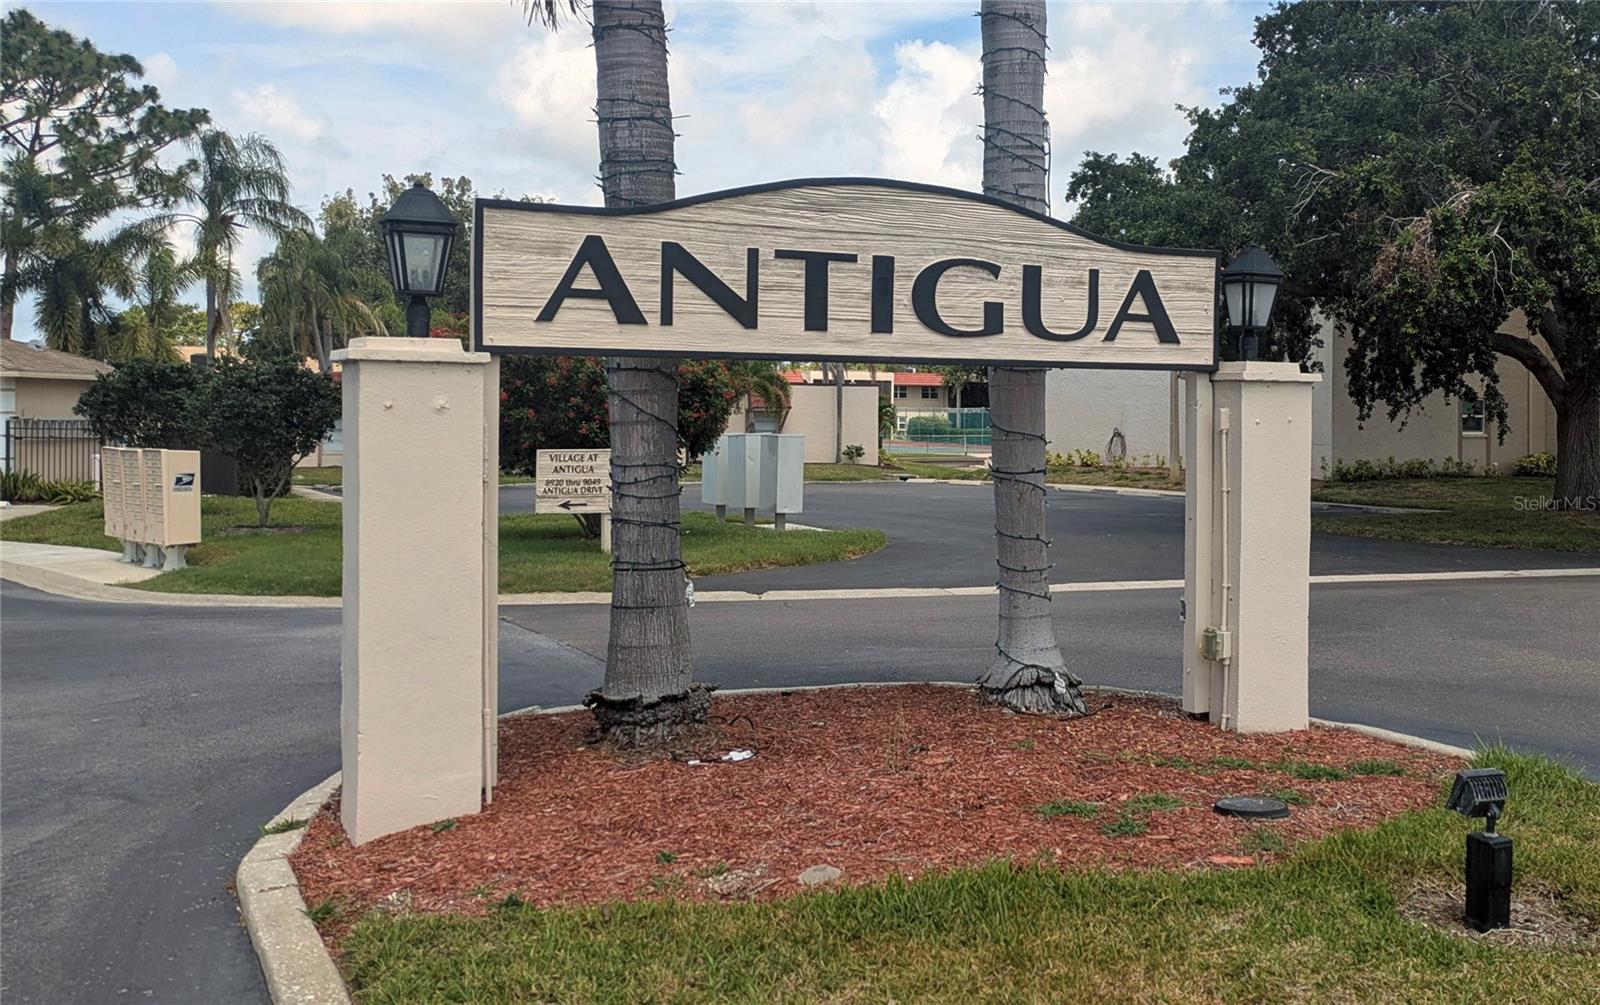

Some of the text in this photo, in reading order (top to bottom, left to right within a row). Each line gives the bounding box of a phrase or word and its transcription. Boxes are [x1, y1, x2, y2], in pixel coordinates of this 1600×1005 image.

[534, 235, 1181, 344] ANTIGUA
[549, 454, 598, 462] VILLAGE AT
[552, 465, 594, 474] ANTIGUA
[545, 479, 564, 487] 8920
[583, 478, 601, 486] 9049
[543, 486, 603, 495] ANTIGUA DRIVE
